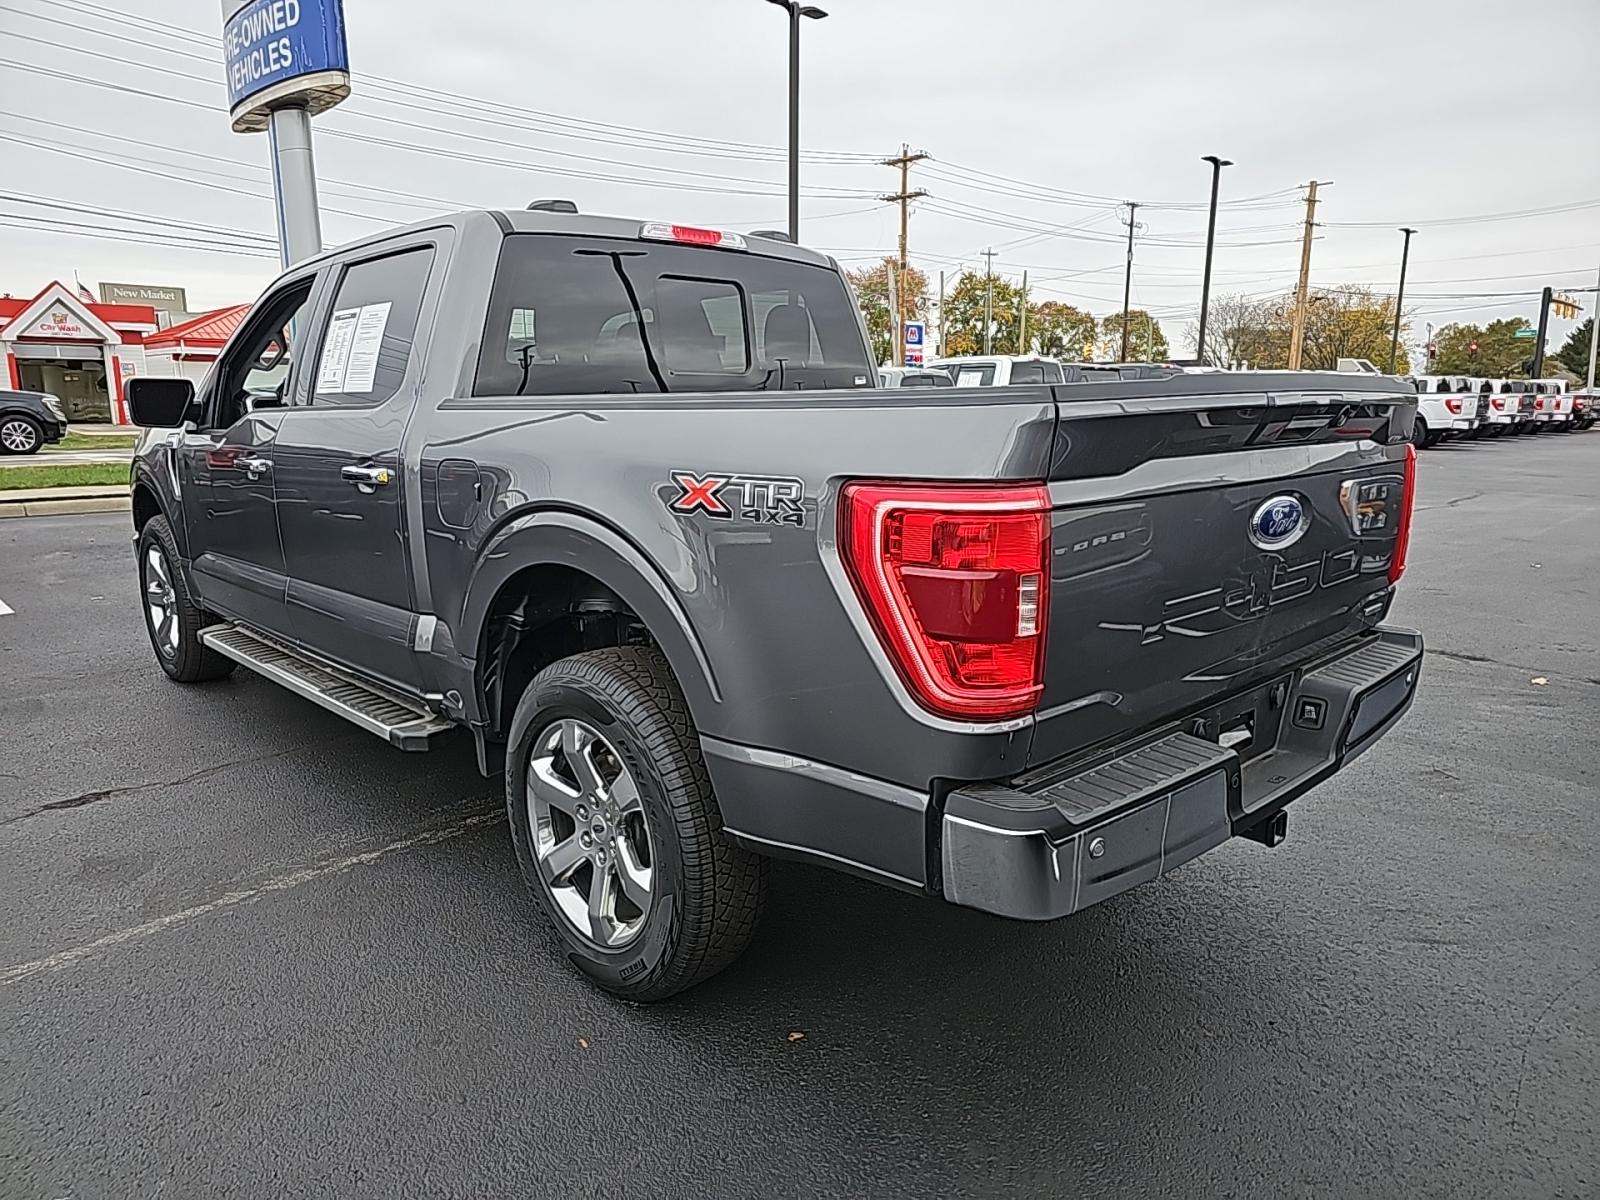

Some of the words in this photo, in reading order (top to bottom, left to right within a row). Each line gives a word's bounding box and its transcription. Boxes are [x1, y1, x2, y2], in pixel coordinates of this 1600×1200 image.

[225, 0, 300, 61] RE-OWNED
[229, 37, 293, 94] VEHICLES
[113, 287, 138, 298] New
[140, 289, 175, 300] Market
[40, 323, 57, 331] Car
[58, 324, 81, 333] Wash
